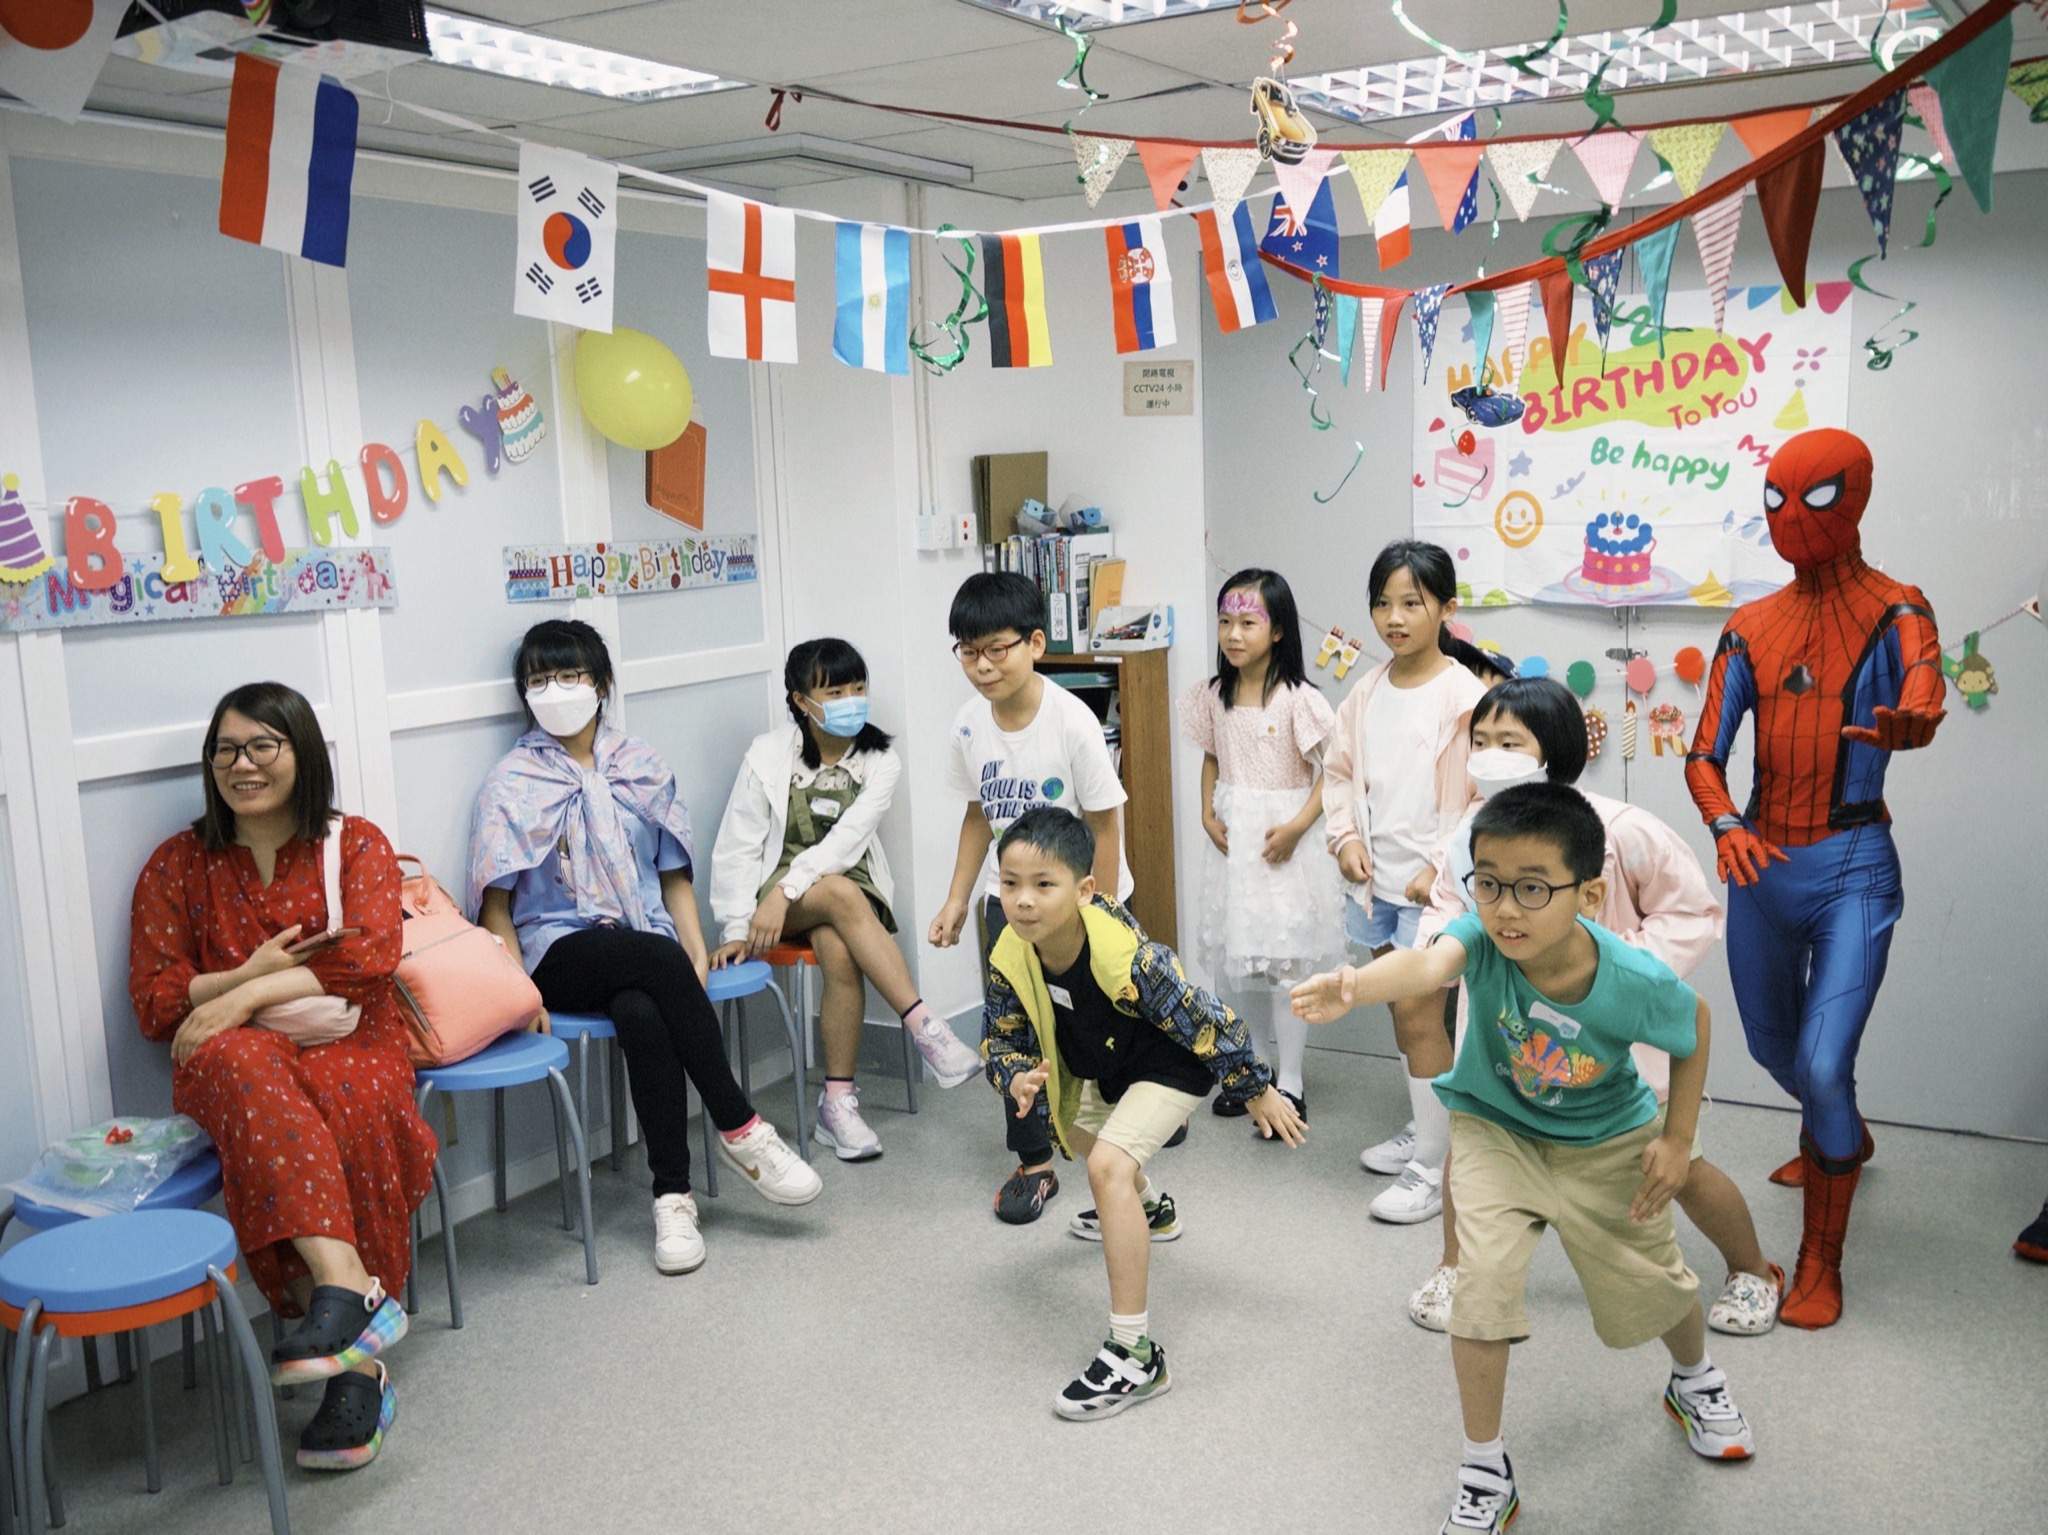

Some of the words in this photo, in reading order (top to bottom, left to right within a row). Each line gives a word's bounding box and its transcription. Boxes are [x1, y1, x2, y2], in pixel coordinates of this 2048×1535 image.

[1133, 384, 1165, 393] CCTV24
[1521, 332, 1773, 434] BIRTHDAY
[1590, 436, 1625, 466] Be
[1632, 440, 1731, 490] happy
[64, 394, 501, 590] BIRTHDAY
[549, 551, 632, 589] Happy
[639, 544, 727, 582] Birthday
[980, 778, 1017, 802] SOUL
[1018, 779, 1037, 800] IS
